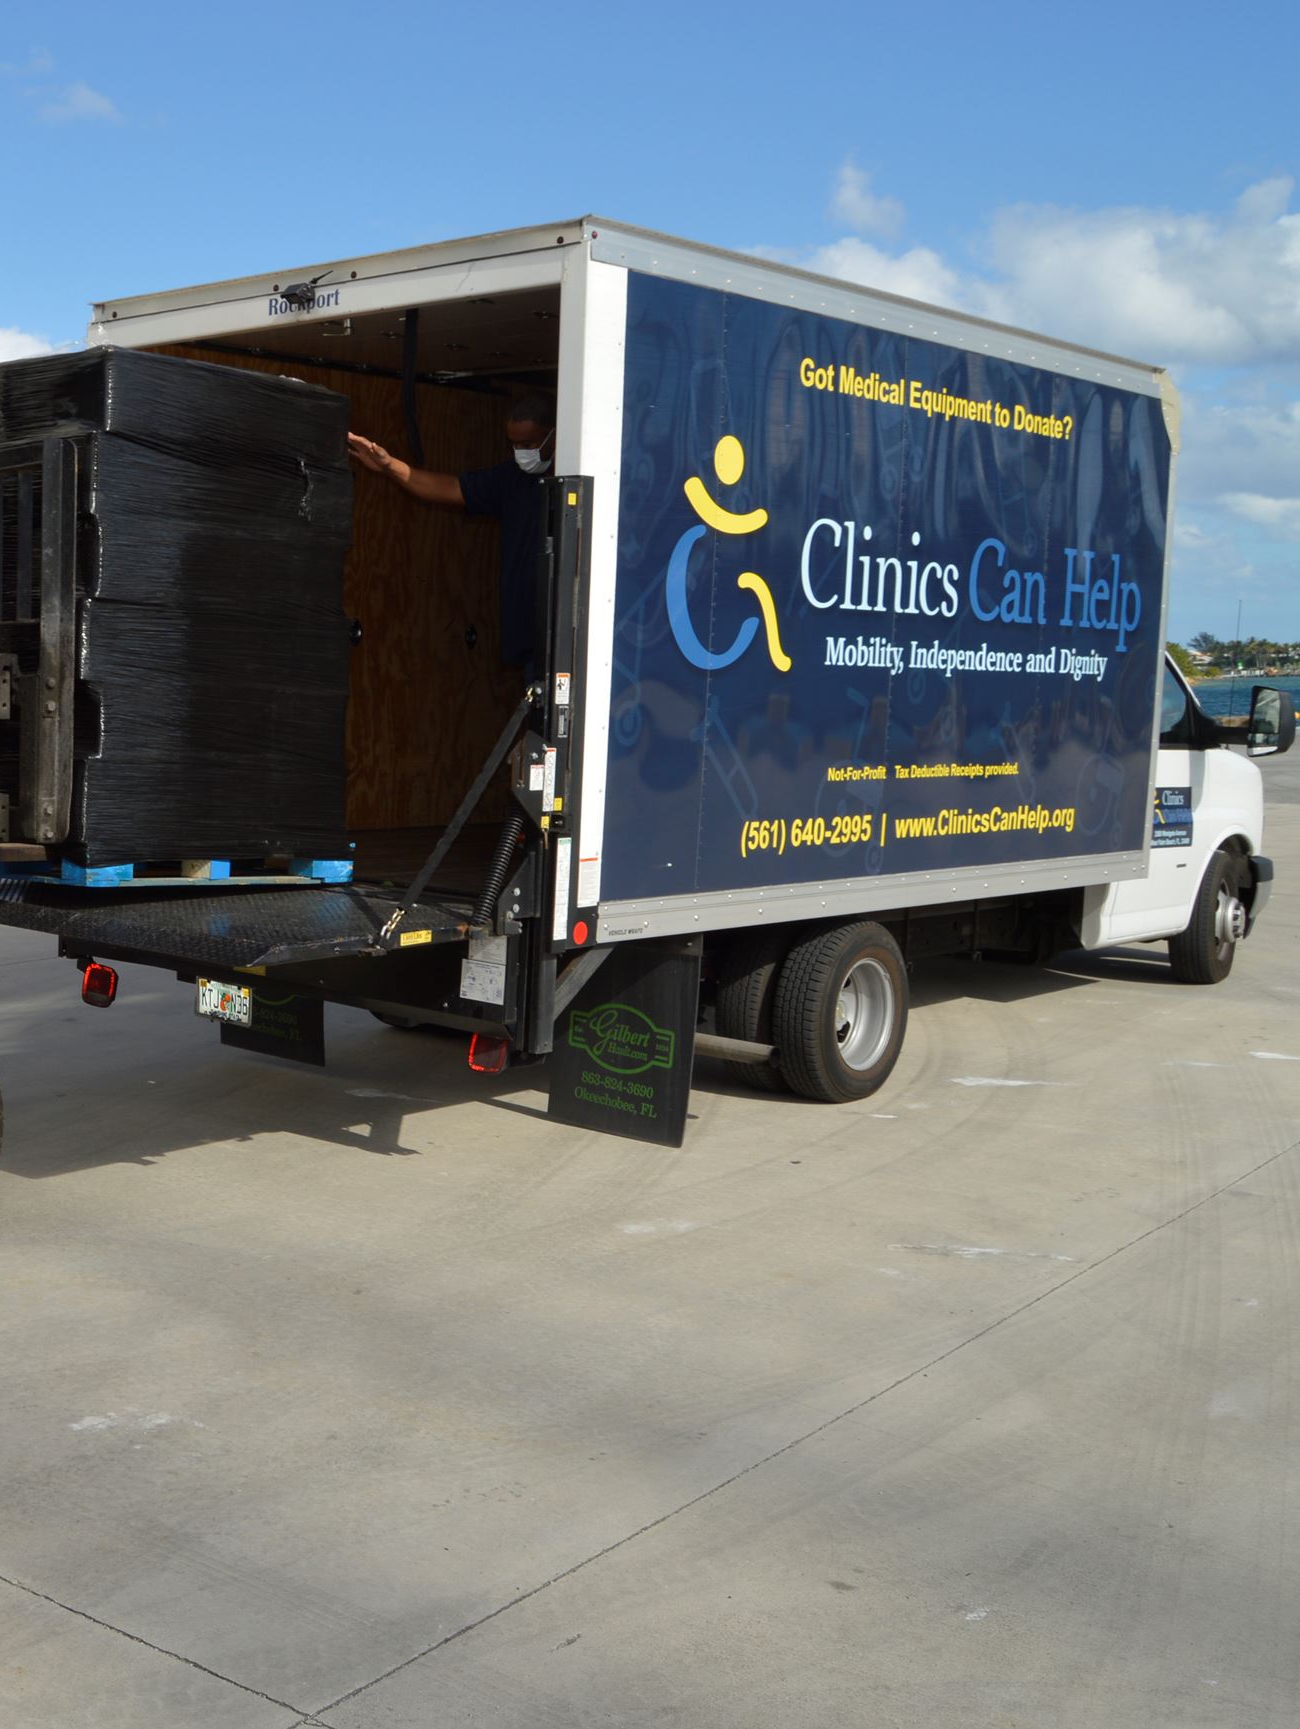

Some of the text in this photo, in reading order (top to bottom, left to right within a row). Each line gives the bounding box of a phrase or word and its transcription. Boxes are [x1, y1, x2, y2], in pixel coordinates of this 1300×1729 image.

[800, 358, 1073, 440] Got Medical Equipment to Donate?
[801, 518, 1142, 652] Clinics Can Help
[824, 636, 1108, 681] Mobility, Independence and Dignity
[828, 762, 1019, 781] Not-For-Profit Tax Deductible Receipts provided.
[741, 804, 1076, 858] (561) 640-2995 www.ClinicsCanHelp.org
[589, 1010, 650, 1055] Gilbert
[640, 1103, 657, 1119] FL
